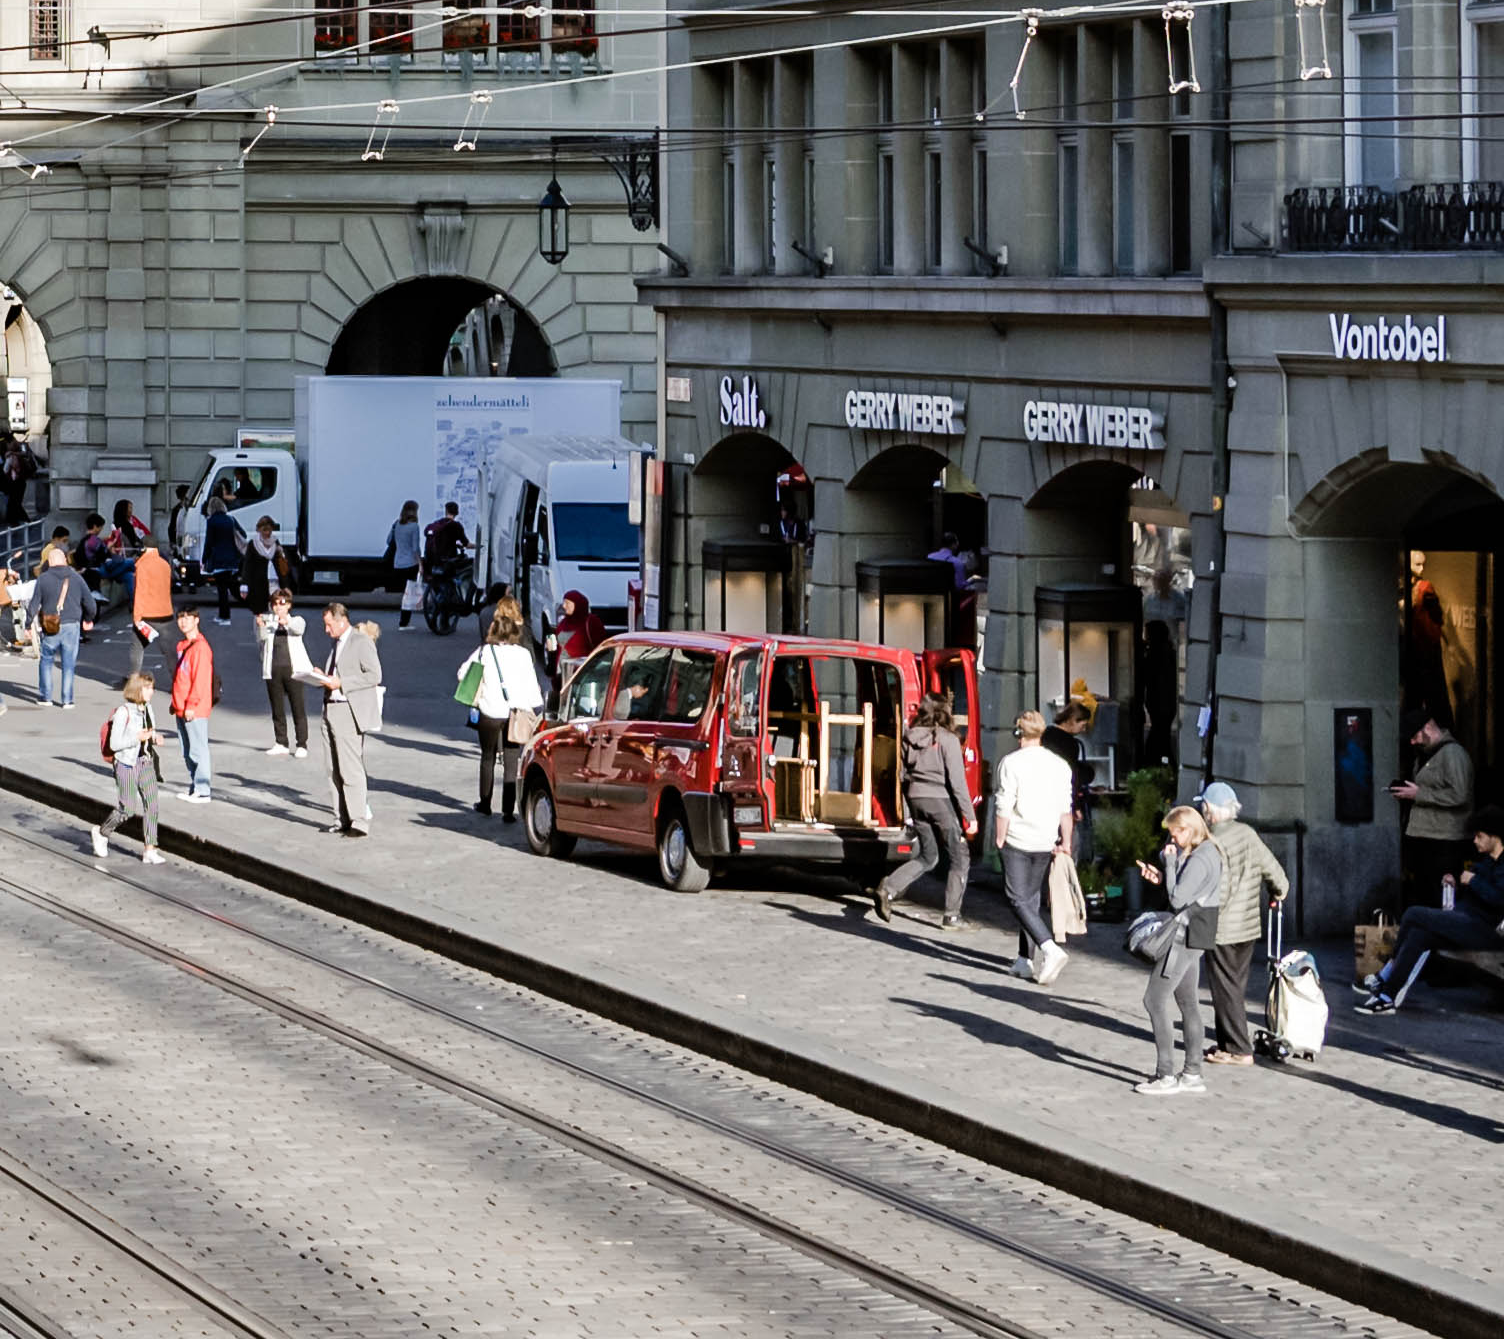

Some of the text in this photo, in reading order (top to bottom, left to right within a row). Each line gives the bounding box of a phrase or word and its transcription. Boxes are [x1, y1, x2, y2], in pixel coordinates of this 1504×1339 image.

[1328, 313, 1446, 363] Vontobel
[720, 375, 766, 429] Salt.
[845, 390, 956, 435] GERRY WEBER
[1023, 400, 1154, 450] GERRY WEBER
